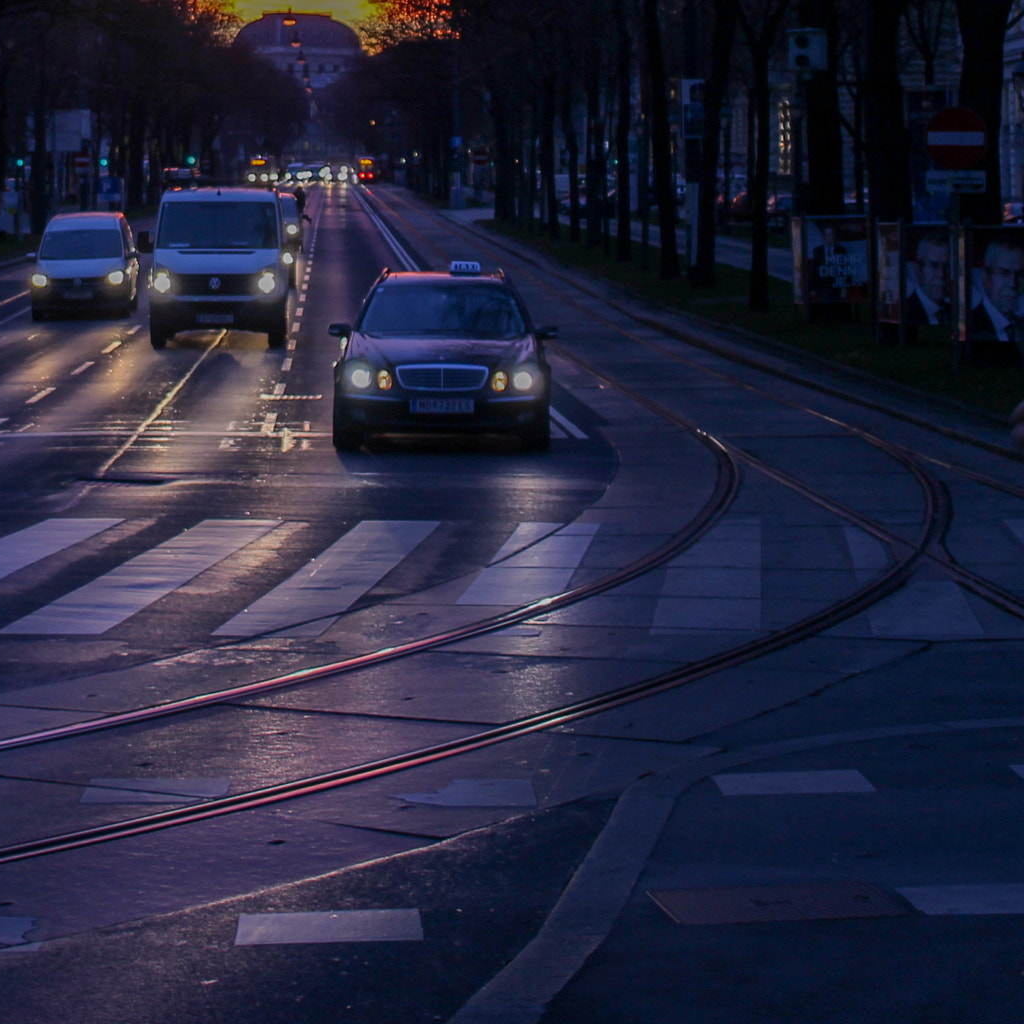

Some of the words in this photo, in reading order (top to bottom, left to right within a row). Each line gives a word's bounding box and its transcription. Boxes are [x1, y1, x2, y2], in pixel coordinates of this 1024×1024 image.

[825, 254, 862, 265] MEHR
[454, 262, 478, 271] TAXI
[819, 265, 856, 277] DENN
